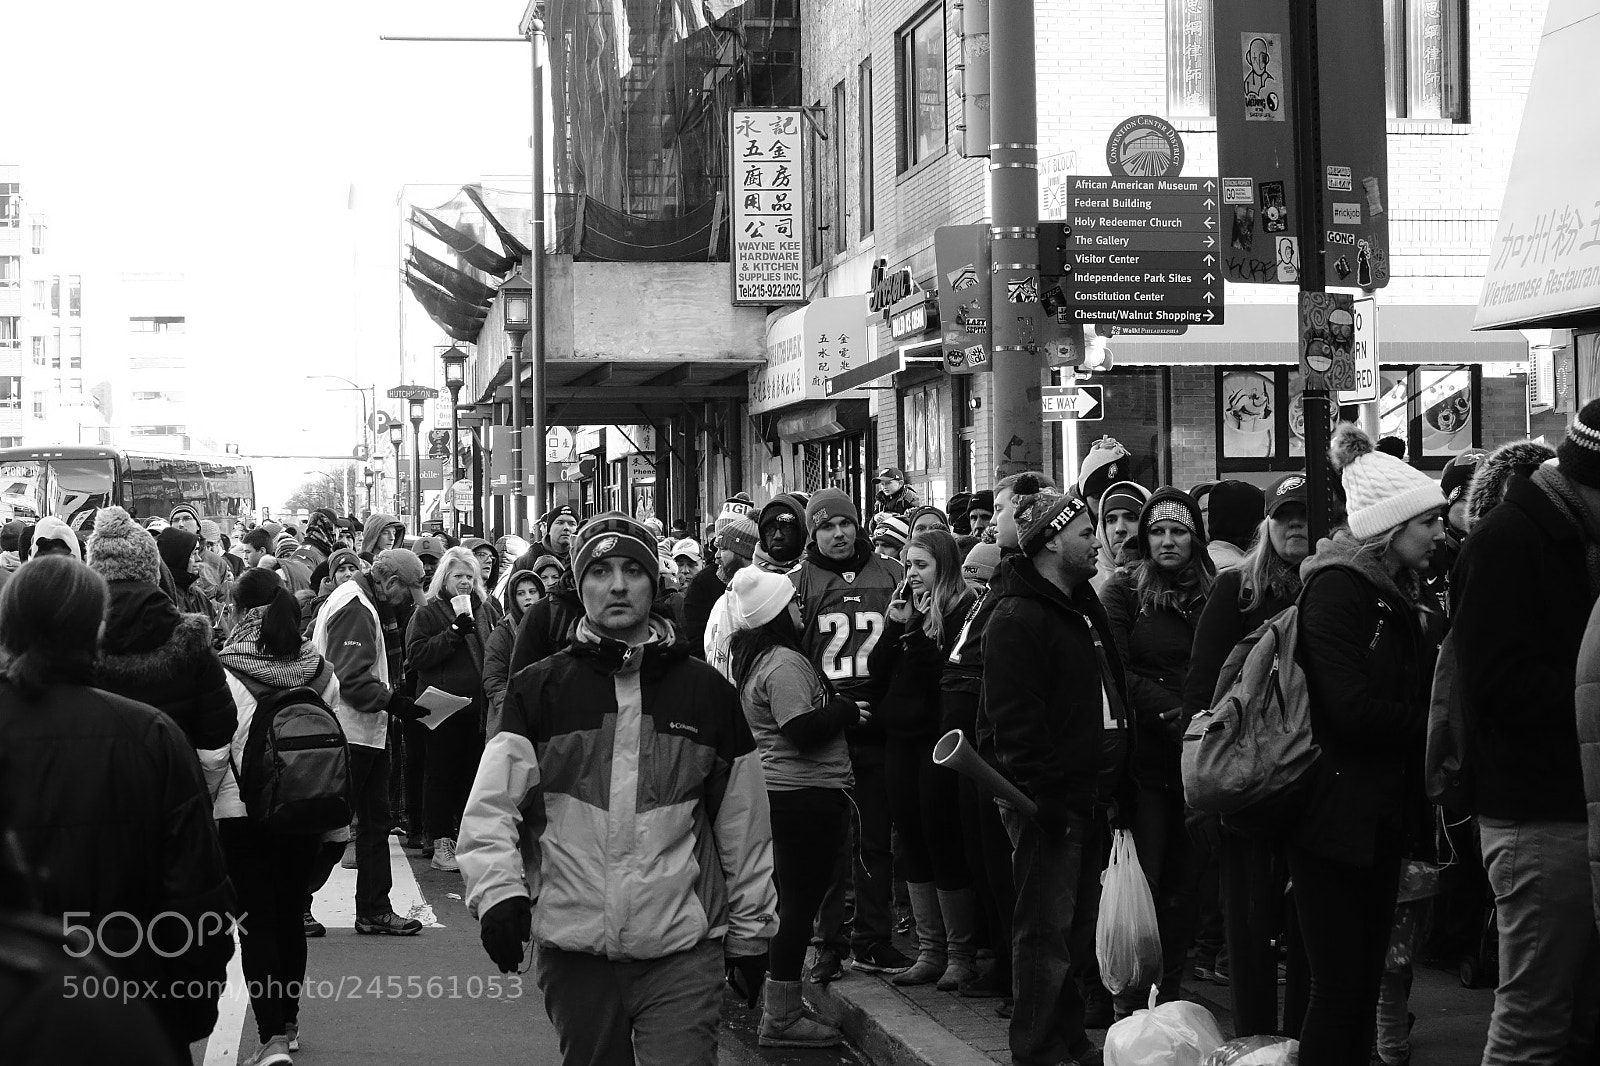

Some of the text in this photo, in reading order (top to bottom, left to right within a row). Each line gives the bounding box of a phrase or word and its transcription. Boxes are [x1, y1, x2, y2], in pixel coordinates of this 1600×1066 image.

[743, 140, 791, 158] 五金
[1075, 180, 1198, 190] African American Museum
[744, 193, 792, 211] 用品
[1074, 198, 1152, 210] Federal Building
[1334, 208, 1360, 219] #rickjob
[1074, 217, 1182, 228] Holy Redeemer Church
[745, 218, 793, 239] 公司
[1075, 236, 1130, 247] The Gallery
[1328, 232, 1354, 245] GONG
[738, 241, 801, 251] WAYNE KEE
[740, 252, 800, 261] HARDWARE
[1075, 254, 1140, 263] Visitor Center
[742, 263, 799, 271] & KITCHEN
[738, 273, 801, 281] SUPPLIES INC.
[1074, 272, 1192, 284] Independence Park Sites
[1074, 291, 1165, 301] Constitution Center
[1483, 277, 1543, 308] Vietnamese
[1074, 310, 1201, 322] Chestnut/Walnut Shopping
[1357, 369, 1373, 389] RED
[1042, 397, 1077, 410] NE WAY
[5, 466, 26, 476] YORK
[1050, 506, 1075, 531] THE
[423, 541, 431, 549] C
[818, 612, 885, 680] 22
